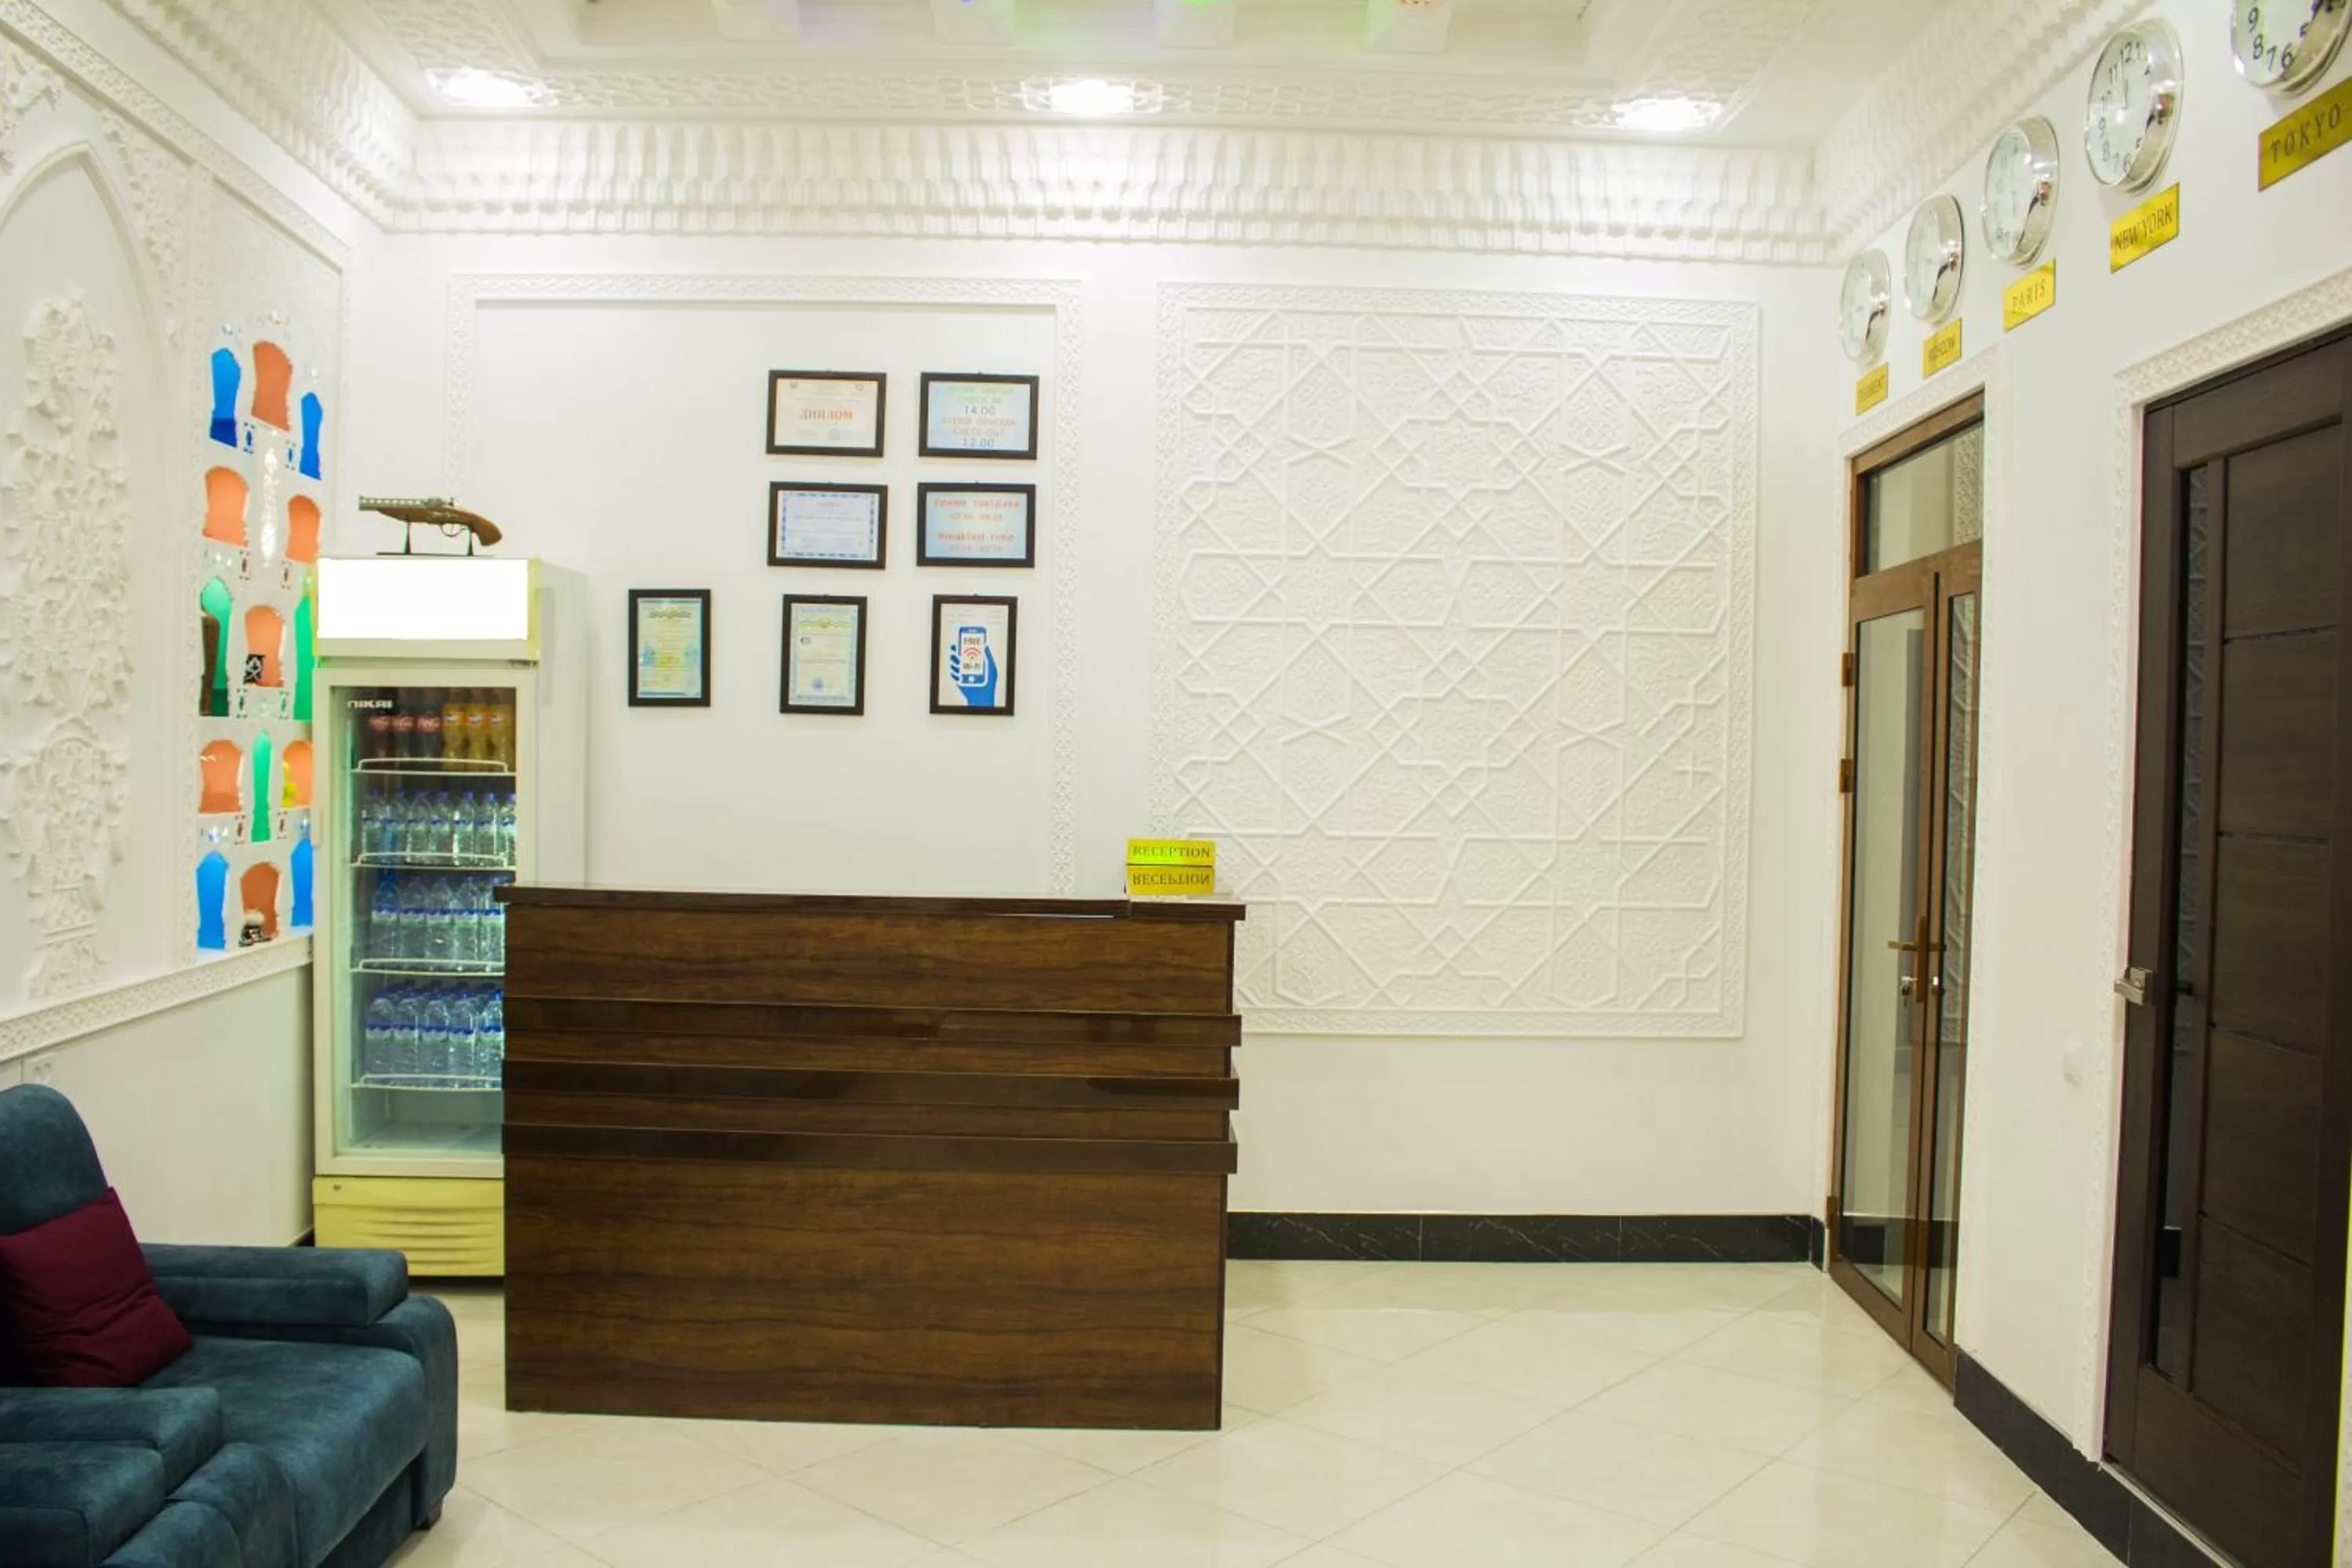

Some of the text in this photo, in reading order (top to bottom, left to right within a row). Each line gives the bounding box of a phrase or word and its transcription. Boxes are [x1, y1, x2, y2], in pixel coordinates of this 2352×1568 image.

[2248, 7, 2259, 33] 9
[2252, 34, 2264, 60] 8
[2266, 45, 2278, 72] 7
[2281, 42, 2294, 69] 6
[2270, 103, 2342, 164] TOKYO
[2114, 201, 2174, 251] NEW YORK
[2012, 278, 2046, 314] PARIS
[1133, 845, 1210, 858] RECEPTION
